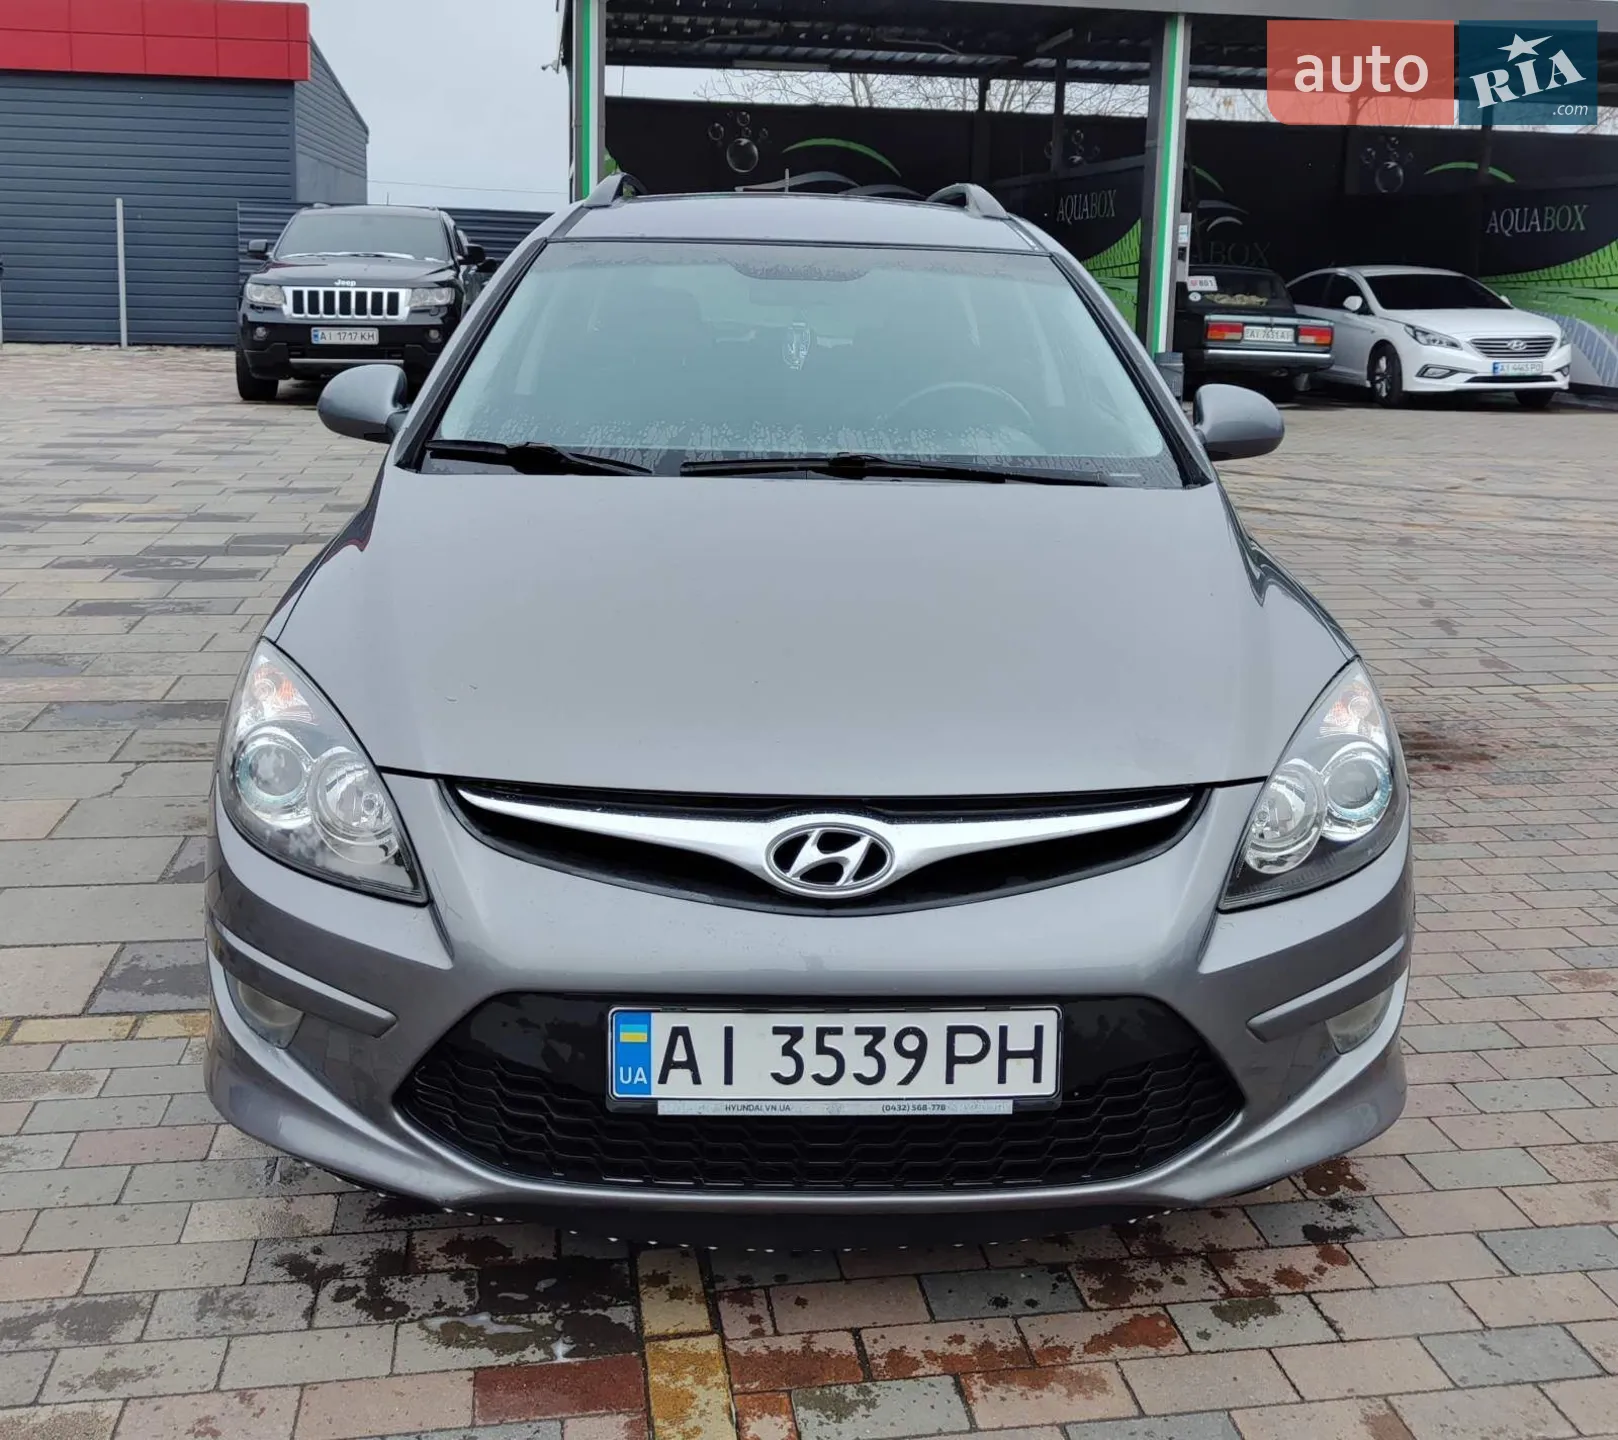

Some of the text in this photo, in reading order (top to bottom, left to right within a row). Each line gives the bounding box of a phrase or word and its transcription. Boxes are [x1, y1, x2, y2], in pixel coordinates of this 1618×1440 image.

[1056, 189, 1117, 225] AQUABOX
[1485, 204, 1589, 237] AQUABOX
[333, 279, 357, 287] Jeep
[337, 331, 358, 341] 1717
[657, 1024, 1045, 1086] AI 3539 PH
[619, 1066, 648, 1085] UA
[881, 1103, 910, 1113] (0432)
